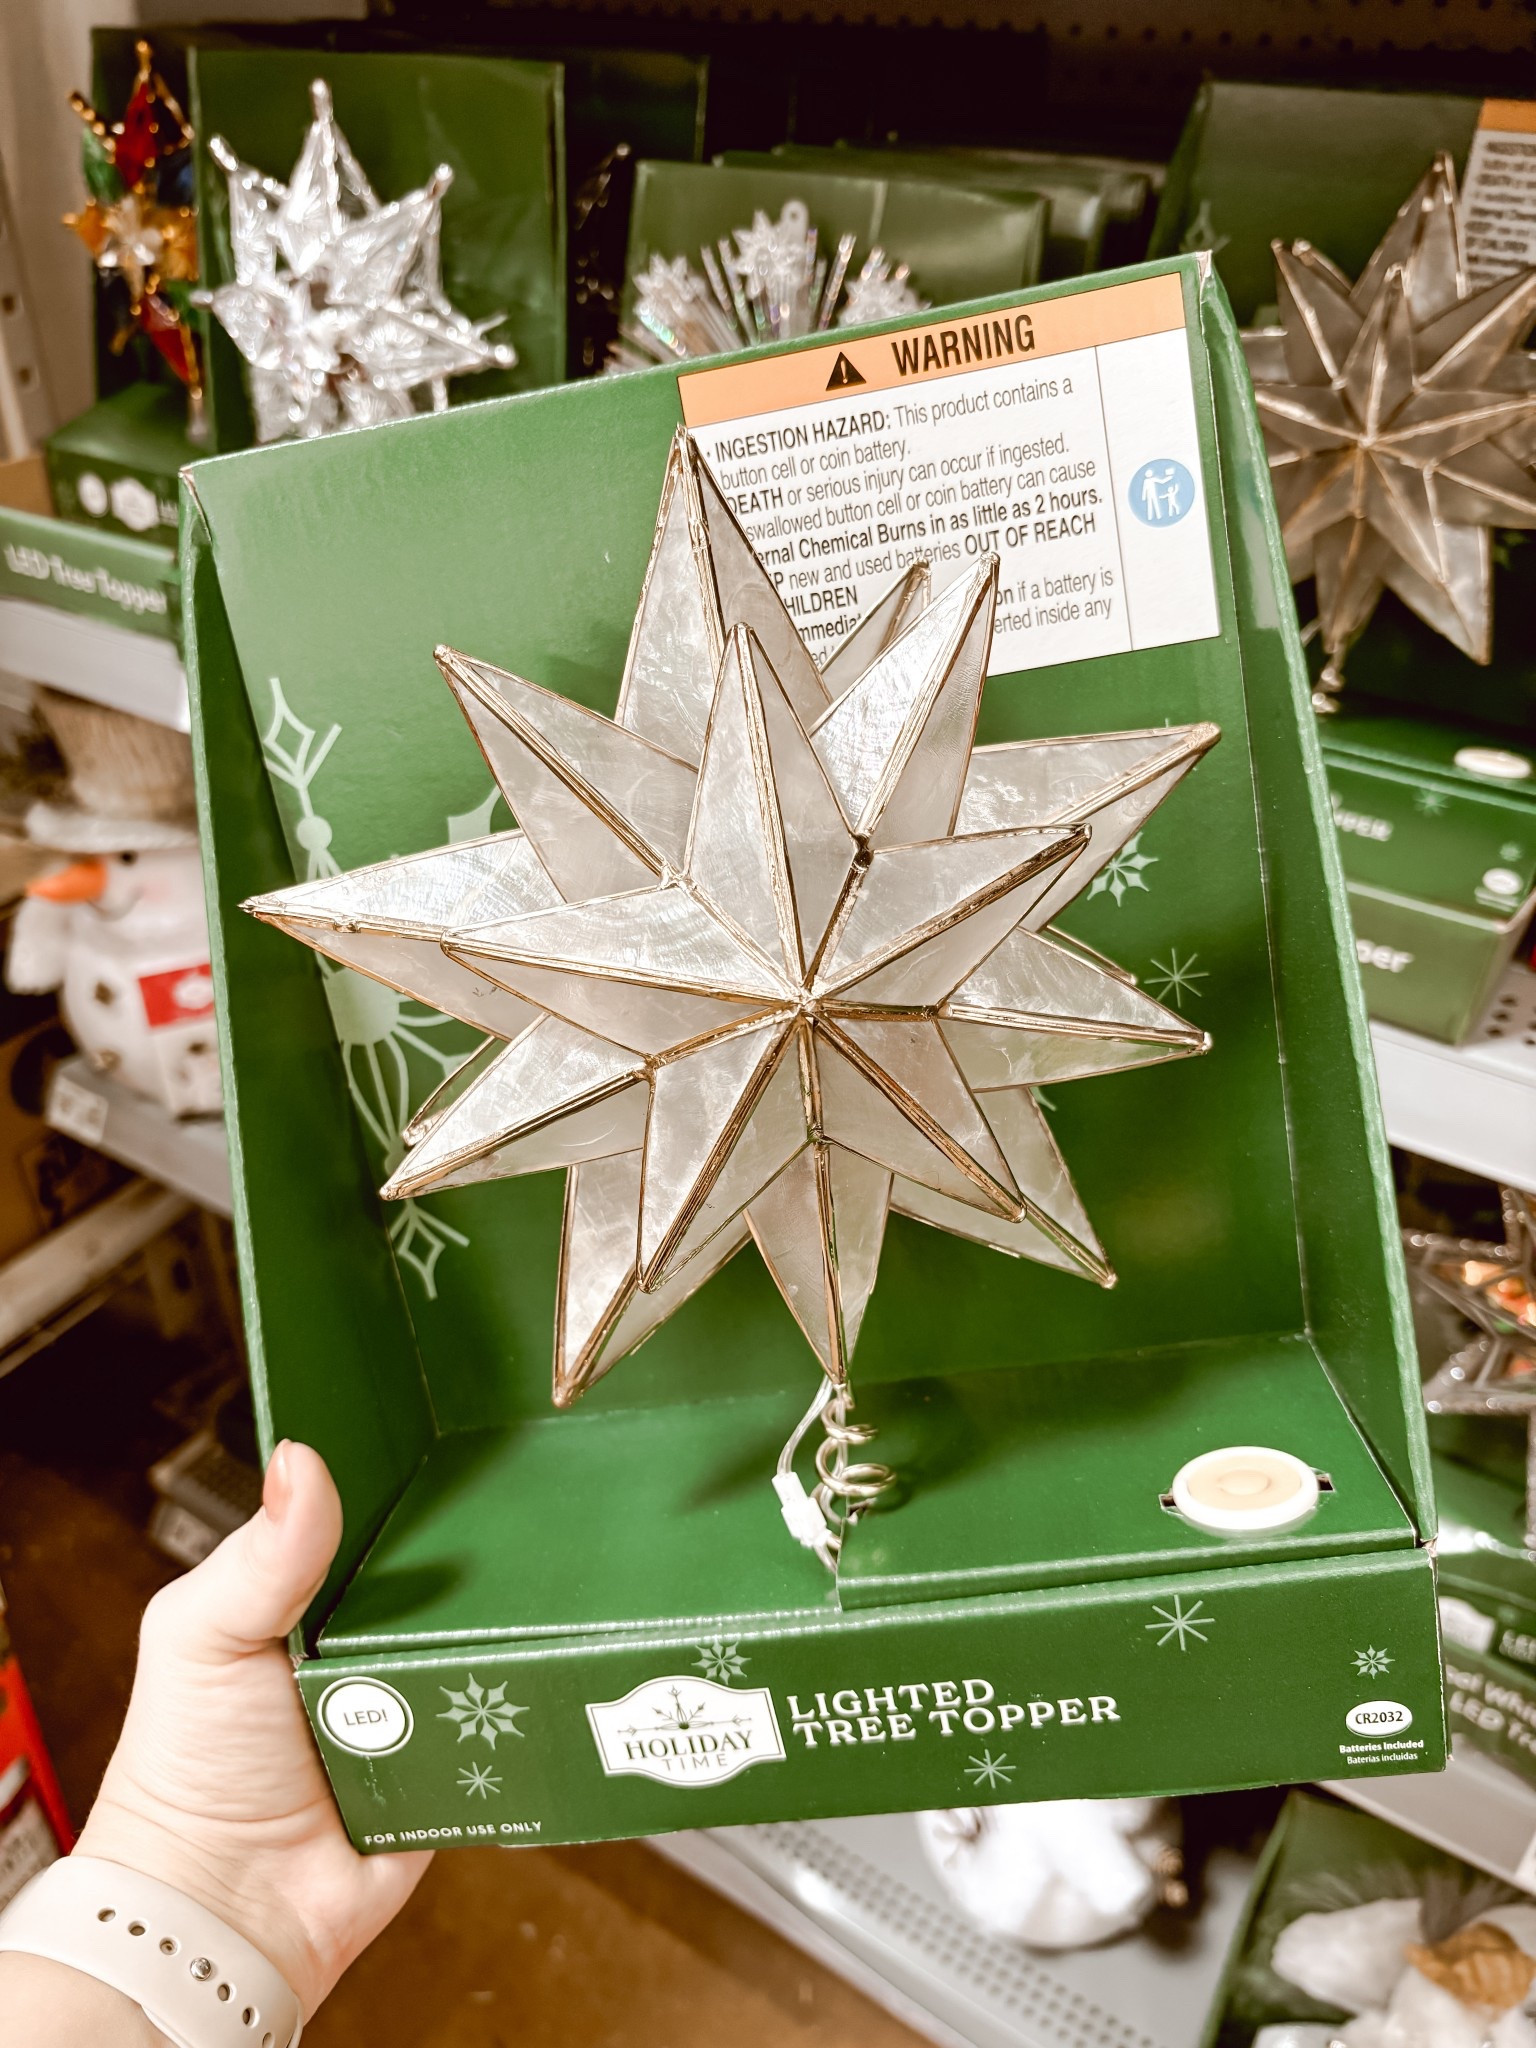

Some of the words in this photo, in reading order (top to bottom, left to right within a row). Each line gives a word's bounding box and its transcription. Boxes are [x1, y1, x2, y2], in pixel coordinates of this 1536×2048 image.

[891, 314, 1035, 376] WARNING
[714, 424, 809, 463] INGESTION
[812, 410, 892, 443] HAZARD:
[894, 404, 928, 427] This
[931, 391, 990, 426] product
[993, 379, 1059, 408] contains
[1062, 377, 1074, 395] a
[719, 465, 768, 490] button
[771, 457, 797, 481] cell
[800, 457, 815, 475] or
[819, 448, 850, 471] coin
[853, 439, 912, 466] battery.
[787, 488, 802, 506] or
[806, 477, 861, 502] serious
[864, 466, 905, 493] injury
[908, 462, 937, 482] can
[940, 452, 982, 476] occur
[985, 445, 996, 467] if
[998, 432, 1070, 468] ingested.
[745, 505, 822, 541] swallowed
[825, 502, 873, 526] button
[877, 492, 903, 517] cell
[906, 493, 921, 511] or
[925, 483, 957, 507] coin
[959, 475, 1012, 500] battery
[1016, 469, 1046, 490] can
[1049, 460, 1097, 483] cause
[757, 541, 795, 566] ernal
[799, 526, 874, 559] Chemical
[877, 520, 926, 544] Burns
[930, 514, 946, 535] in
[950, 512, 969, 530] as
[972, 501, 1008, 527] little
[1012, 500, 1031, 519] as
[1036, 494, 1046, 515] 2
[1049, 487, 1103, 512] hours.
[789, 572, 820, 590] new
[824, 558, 851, 582] and
[855, 550, 892, 577] used
[964, 529, 1001, 555] OUT
[1005, 524, 1029, 547] OF
[1034, 512, 1096, 543] REACH
[785, 585, 859, 617] HILDREN
[1017, 580, 1027, 602] if
[1030, 583, 1041, 599] a
[1043, 571, 1097, 598] battery
[1100, 566, 1114, 587] is
[994, 609, 1032, 634] erted
[1035, 601, 1080, 626] inside
[1085, 597, 1112, 620] any
[342, 1707, 389, 1727] LED!
[786, 1678, 995, 1722] LIGHTED
[1355, 1710, 1404, 1725] CR2032
[792, 1712, 917, 1748] TREE
[928, 1695, 1122, 1737] TOPPER
[623, 1730, 753, 1760] HOLIDAY
[662, 1753, 728, 1771] TIME
[1339, 1742, 1382, 1754] Batteries
[1383, 1740, 1424, 1751] Included
[364, 1832, 396, 1845] FOR
[399, 1826, 463, 1842] INDOOR
[466, 1824, 497, 1836] USE
[500, 1820, 542, 1834] ONLY
